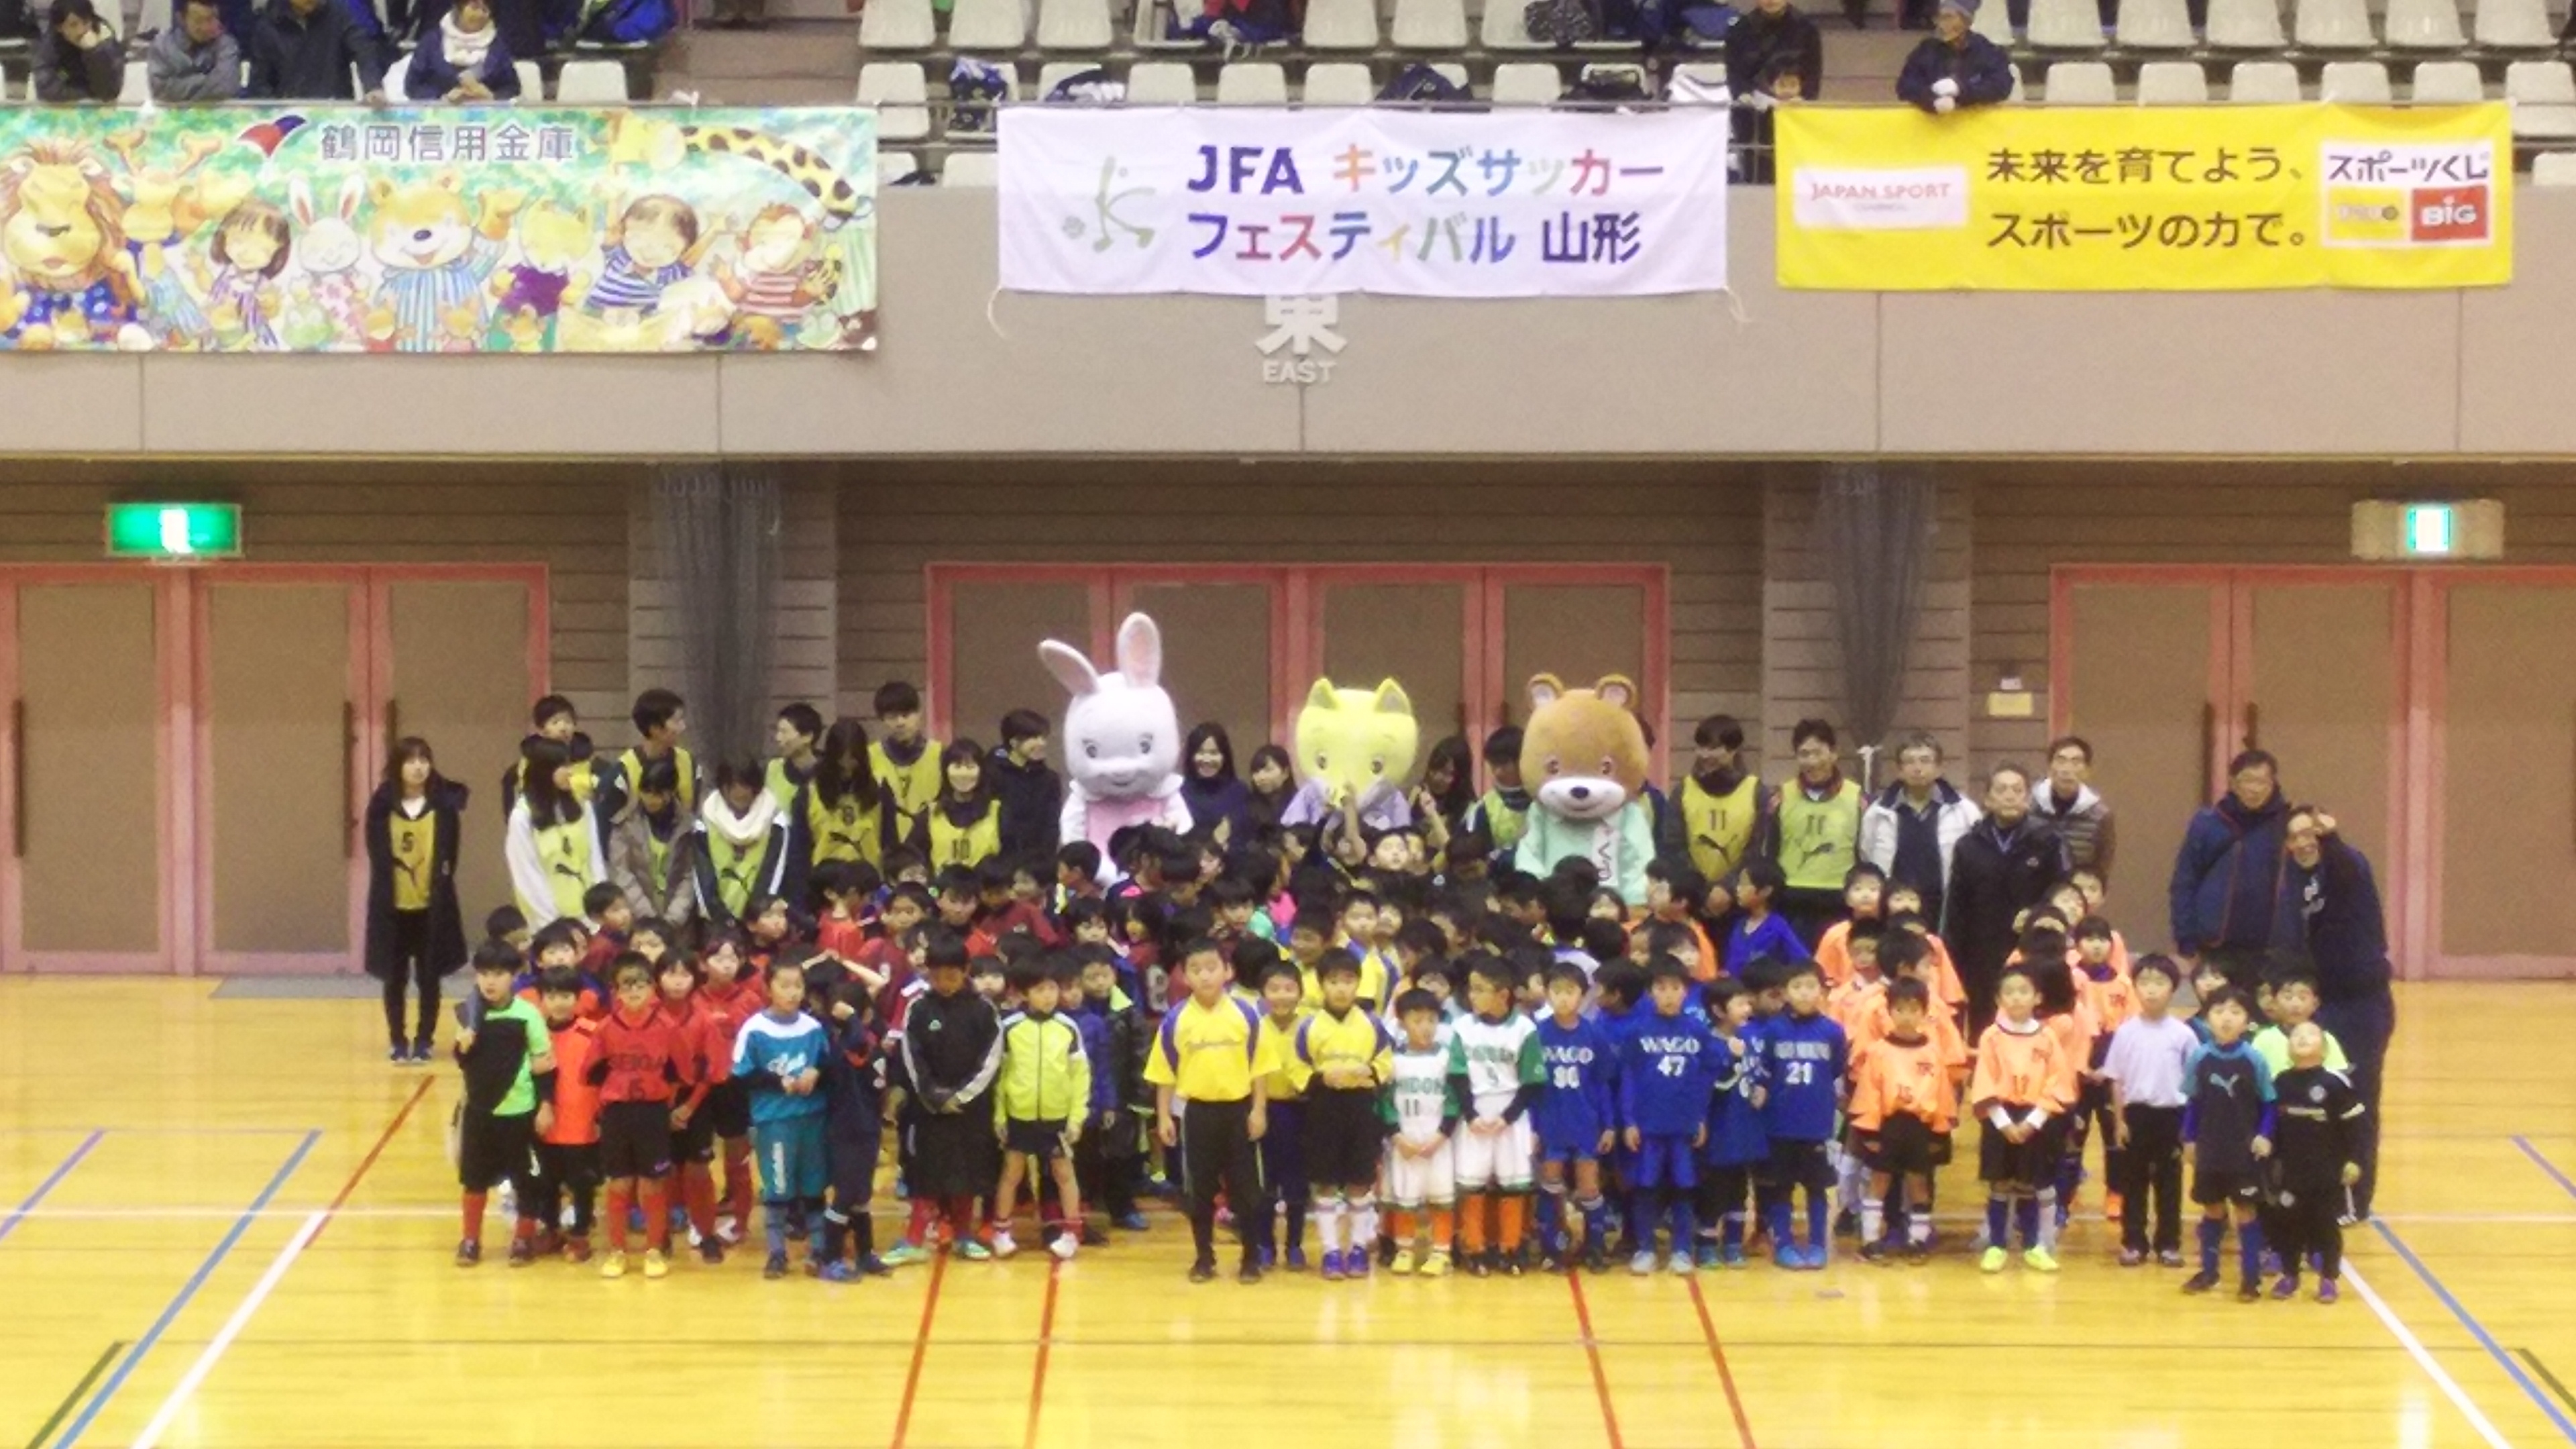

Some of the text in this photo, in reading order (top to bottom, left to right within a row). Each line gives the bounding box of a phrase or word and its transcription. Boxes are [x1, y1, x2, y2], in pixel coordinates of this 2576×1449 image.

[321, 123, 574, 162] 鶴岡信用金庫
[1187, 144, 1664, 196] JFA キッズサッカー
[1987, 148, 2302, 184] 未来を育てよう、
[1811, 182, 1951, 201] JAPAN SPORT
[1187, 211, 1641, 264] フェスティバル 山形
[1988, 211, 2305, 249] スポーツの力で。
[1263, 359, 1338, 382] EAST
[1640, 1036, 1701, 1055] WAGO
[1658, 1055, 1686, 1077] 47
[1786, 1061, 1812, 1085] 21
